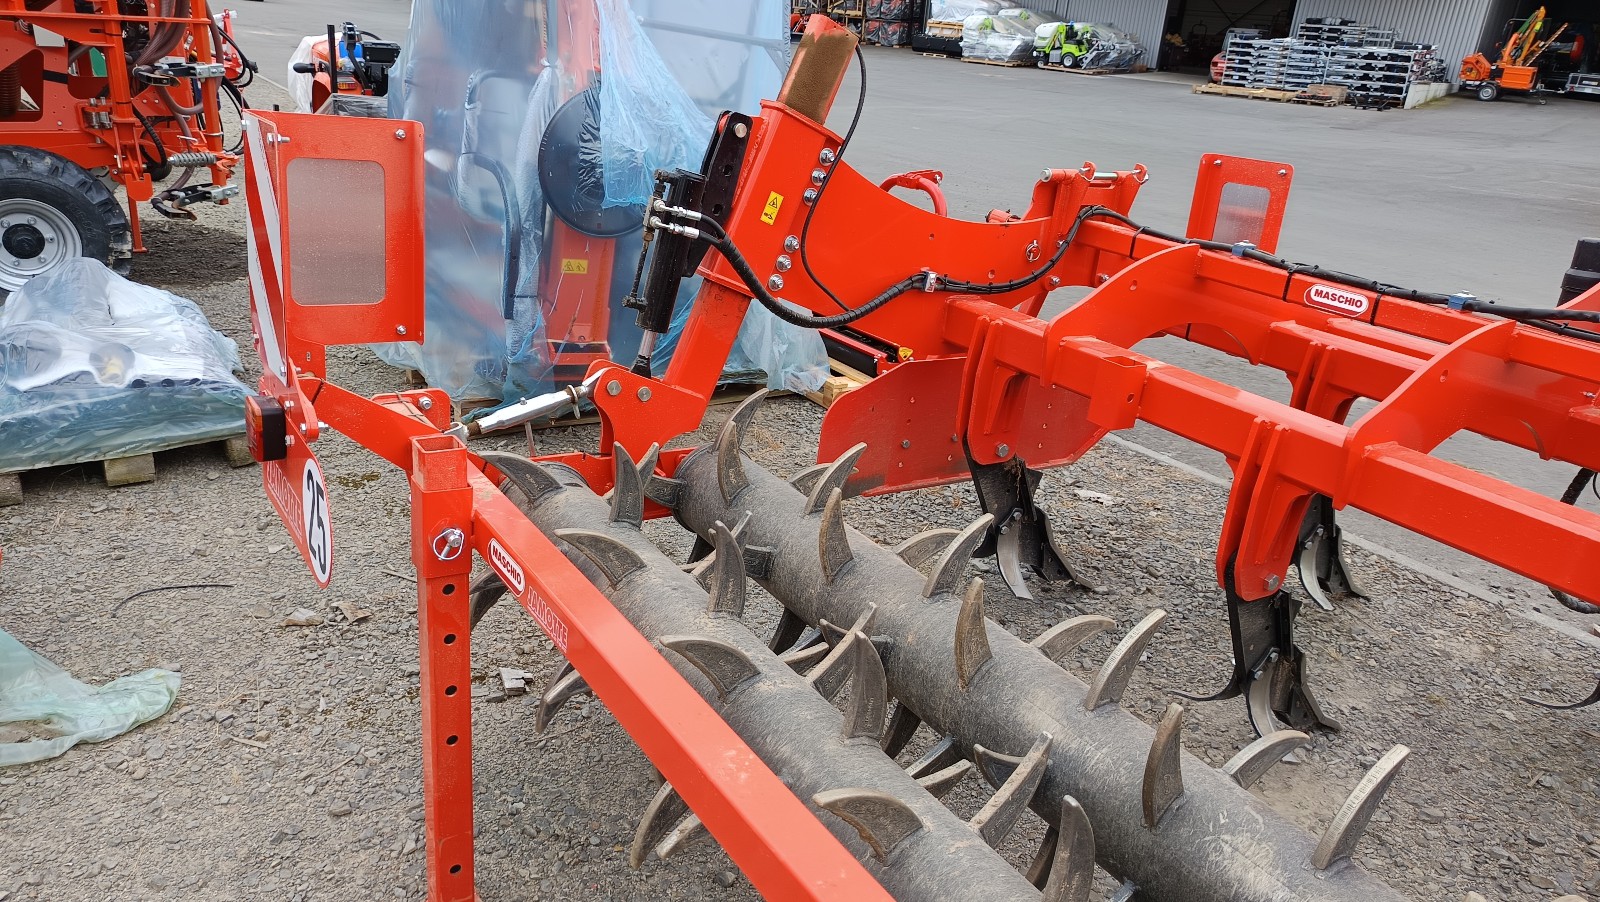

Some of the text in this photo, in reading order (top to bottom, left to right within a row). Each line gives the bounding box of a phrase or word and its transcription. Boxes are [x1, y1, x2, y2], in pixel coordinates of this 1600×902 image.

[1313, 288, 1363, 309] MASCHIO
[306, 468, 327, 575] 25
[492, 544, 522, 586] MASCHIO
[527, 585, 569, 649] JAMOTTE
